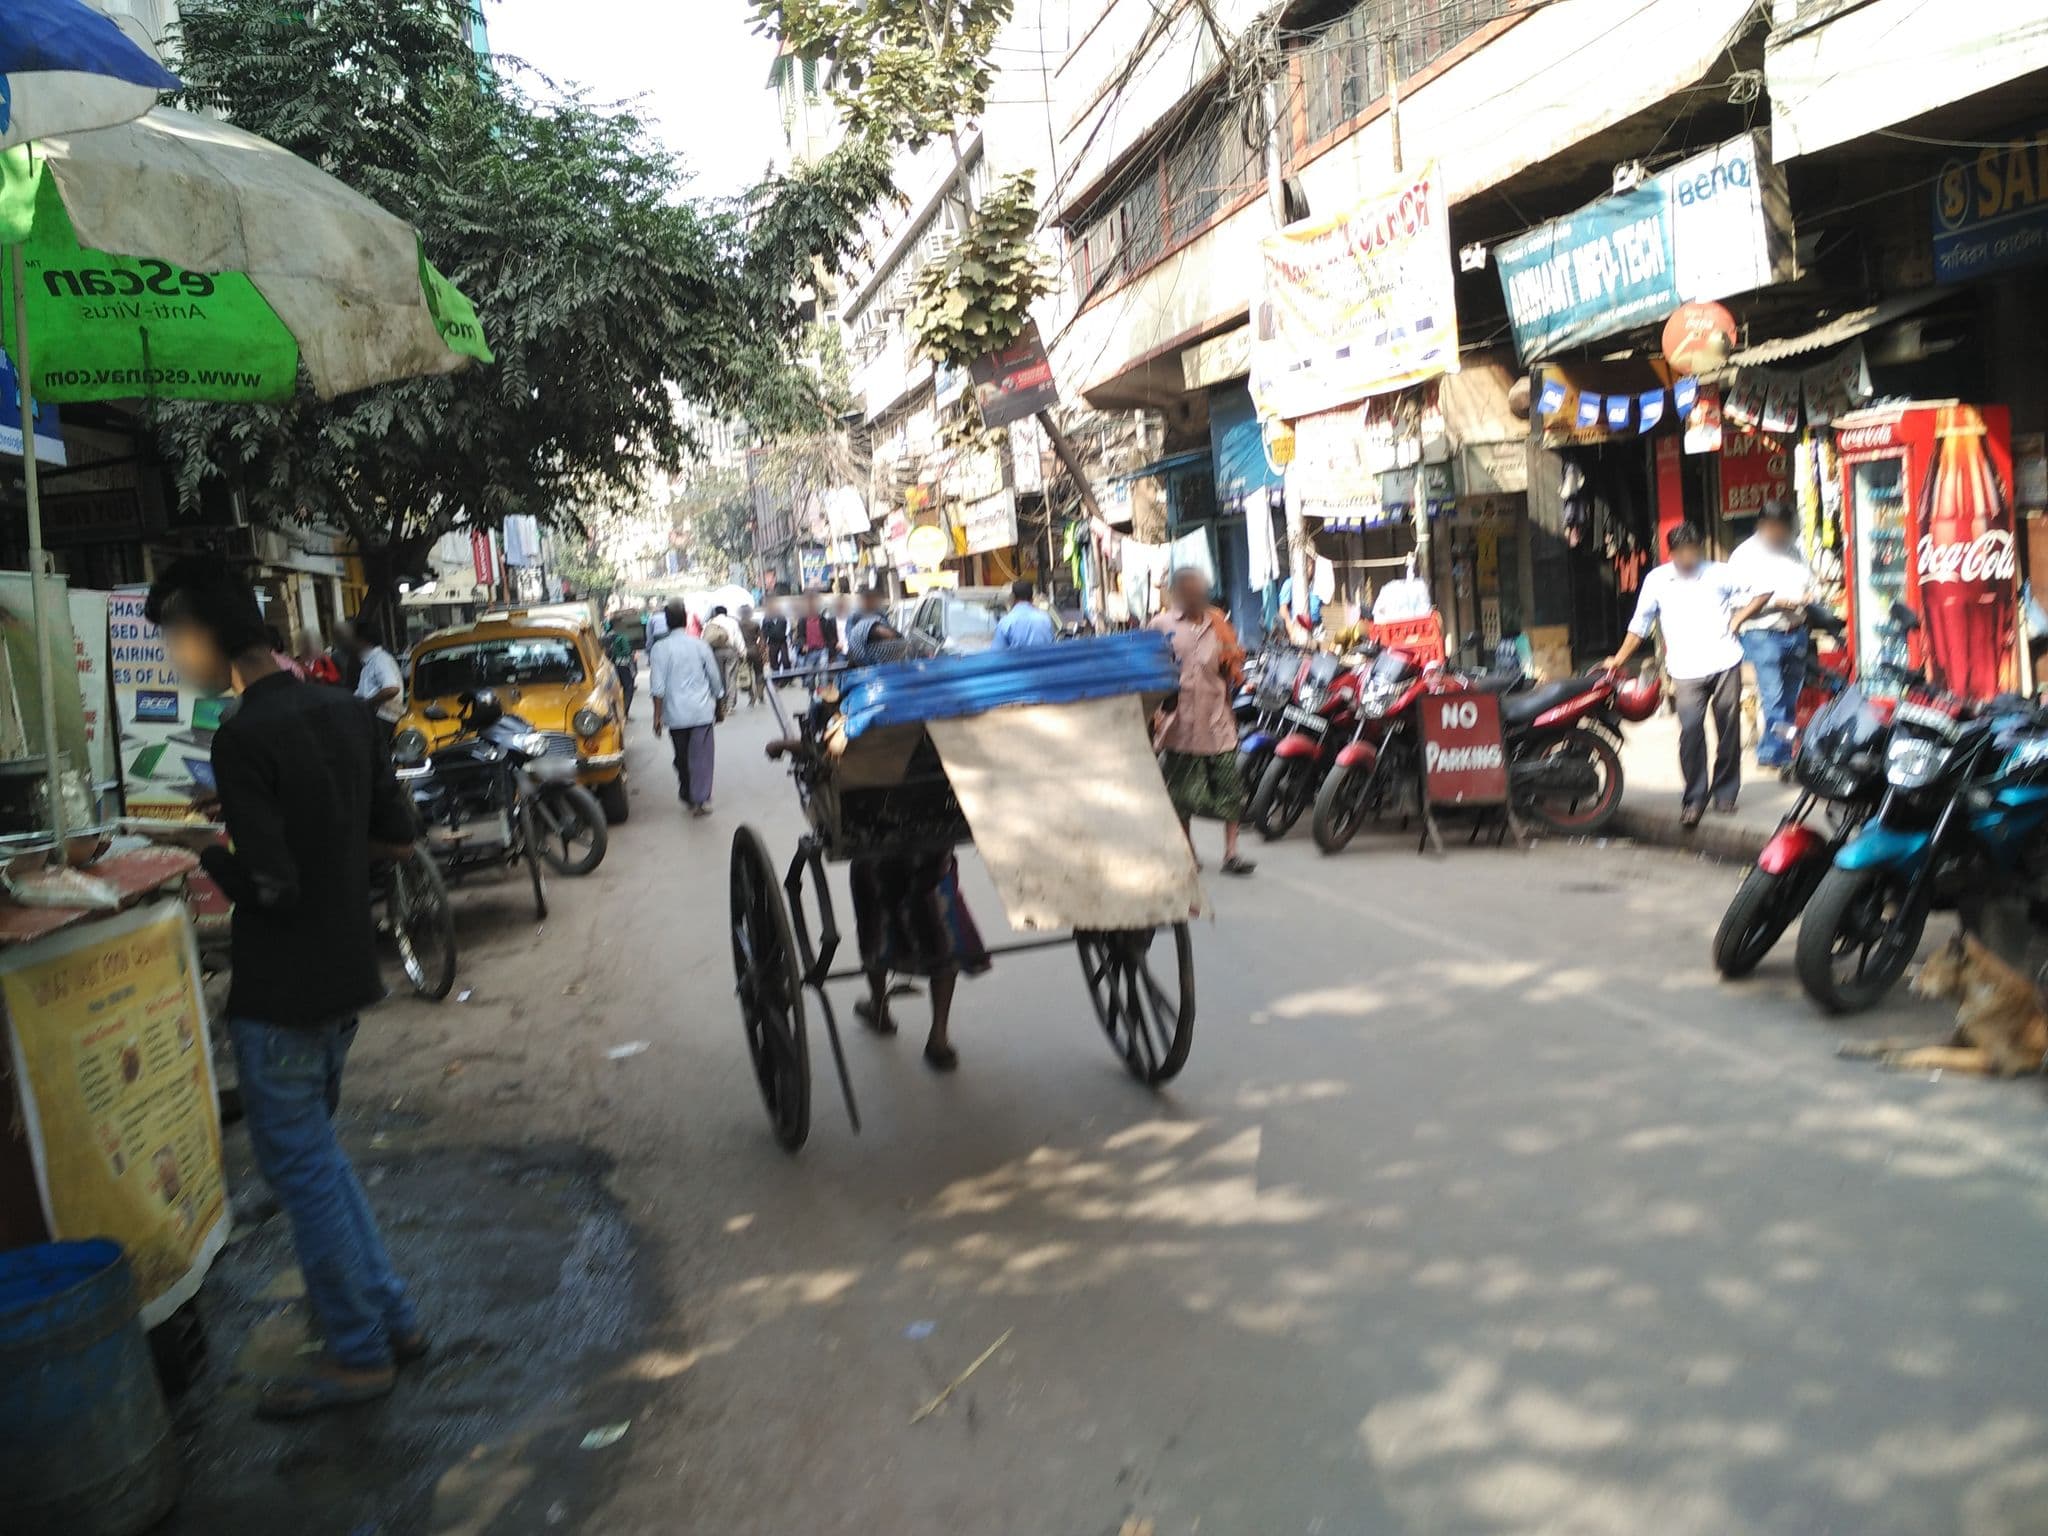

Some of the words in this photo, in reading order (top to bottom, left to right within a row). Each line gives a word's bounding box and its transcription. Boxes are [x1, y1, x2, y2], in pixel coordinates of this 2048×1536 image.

[136, 669, 154, 685] OF
[138, 696, 176, 710] acer
[1441, 701, 1478, 729] NO
[1425, 740, 1503, 774] PARKING
